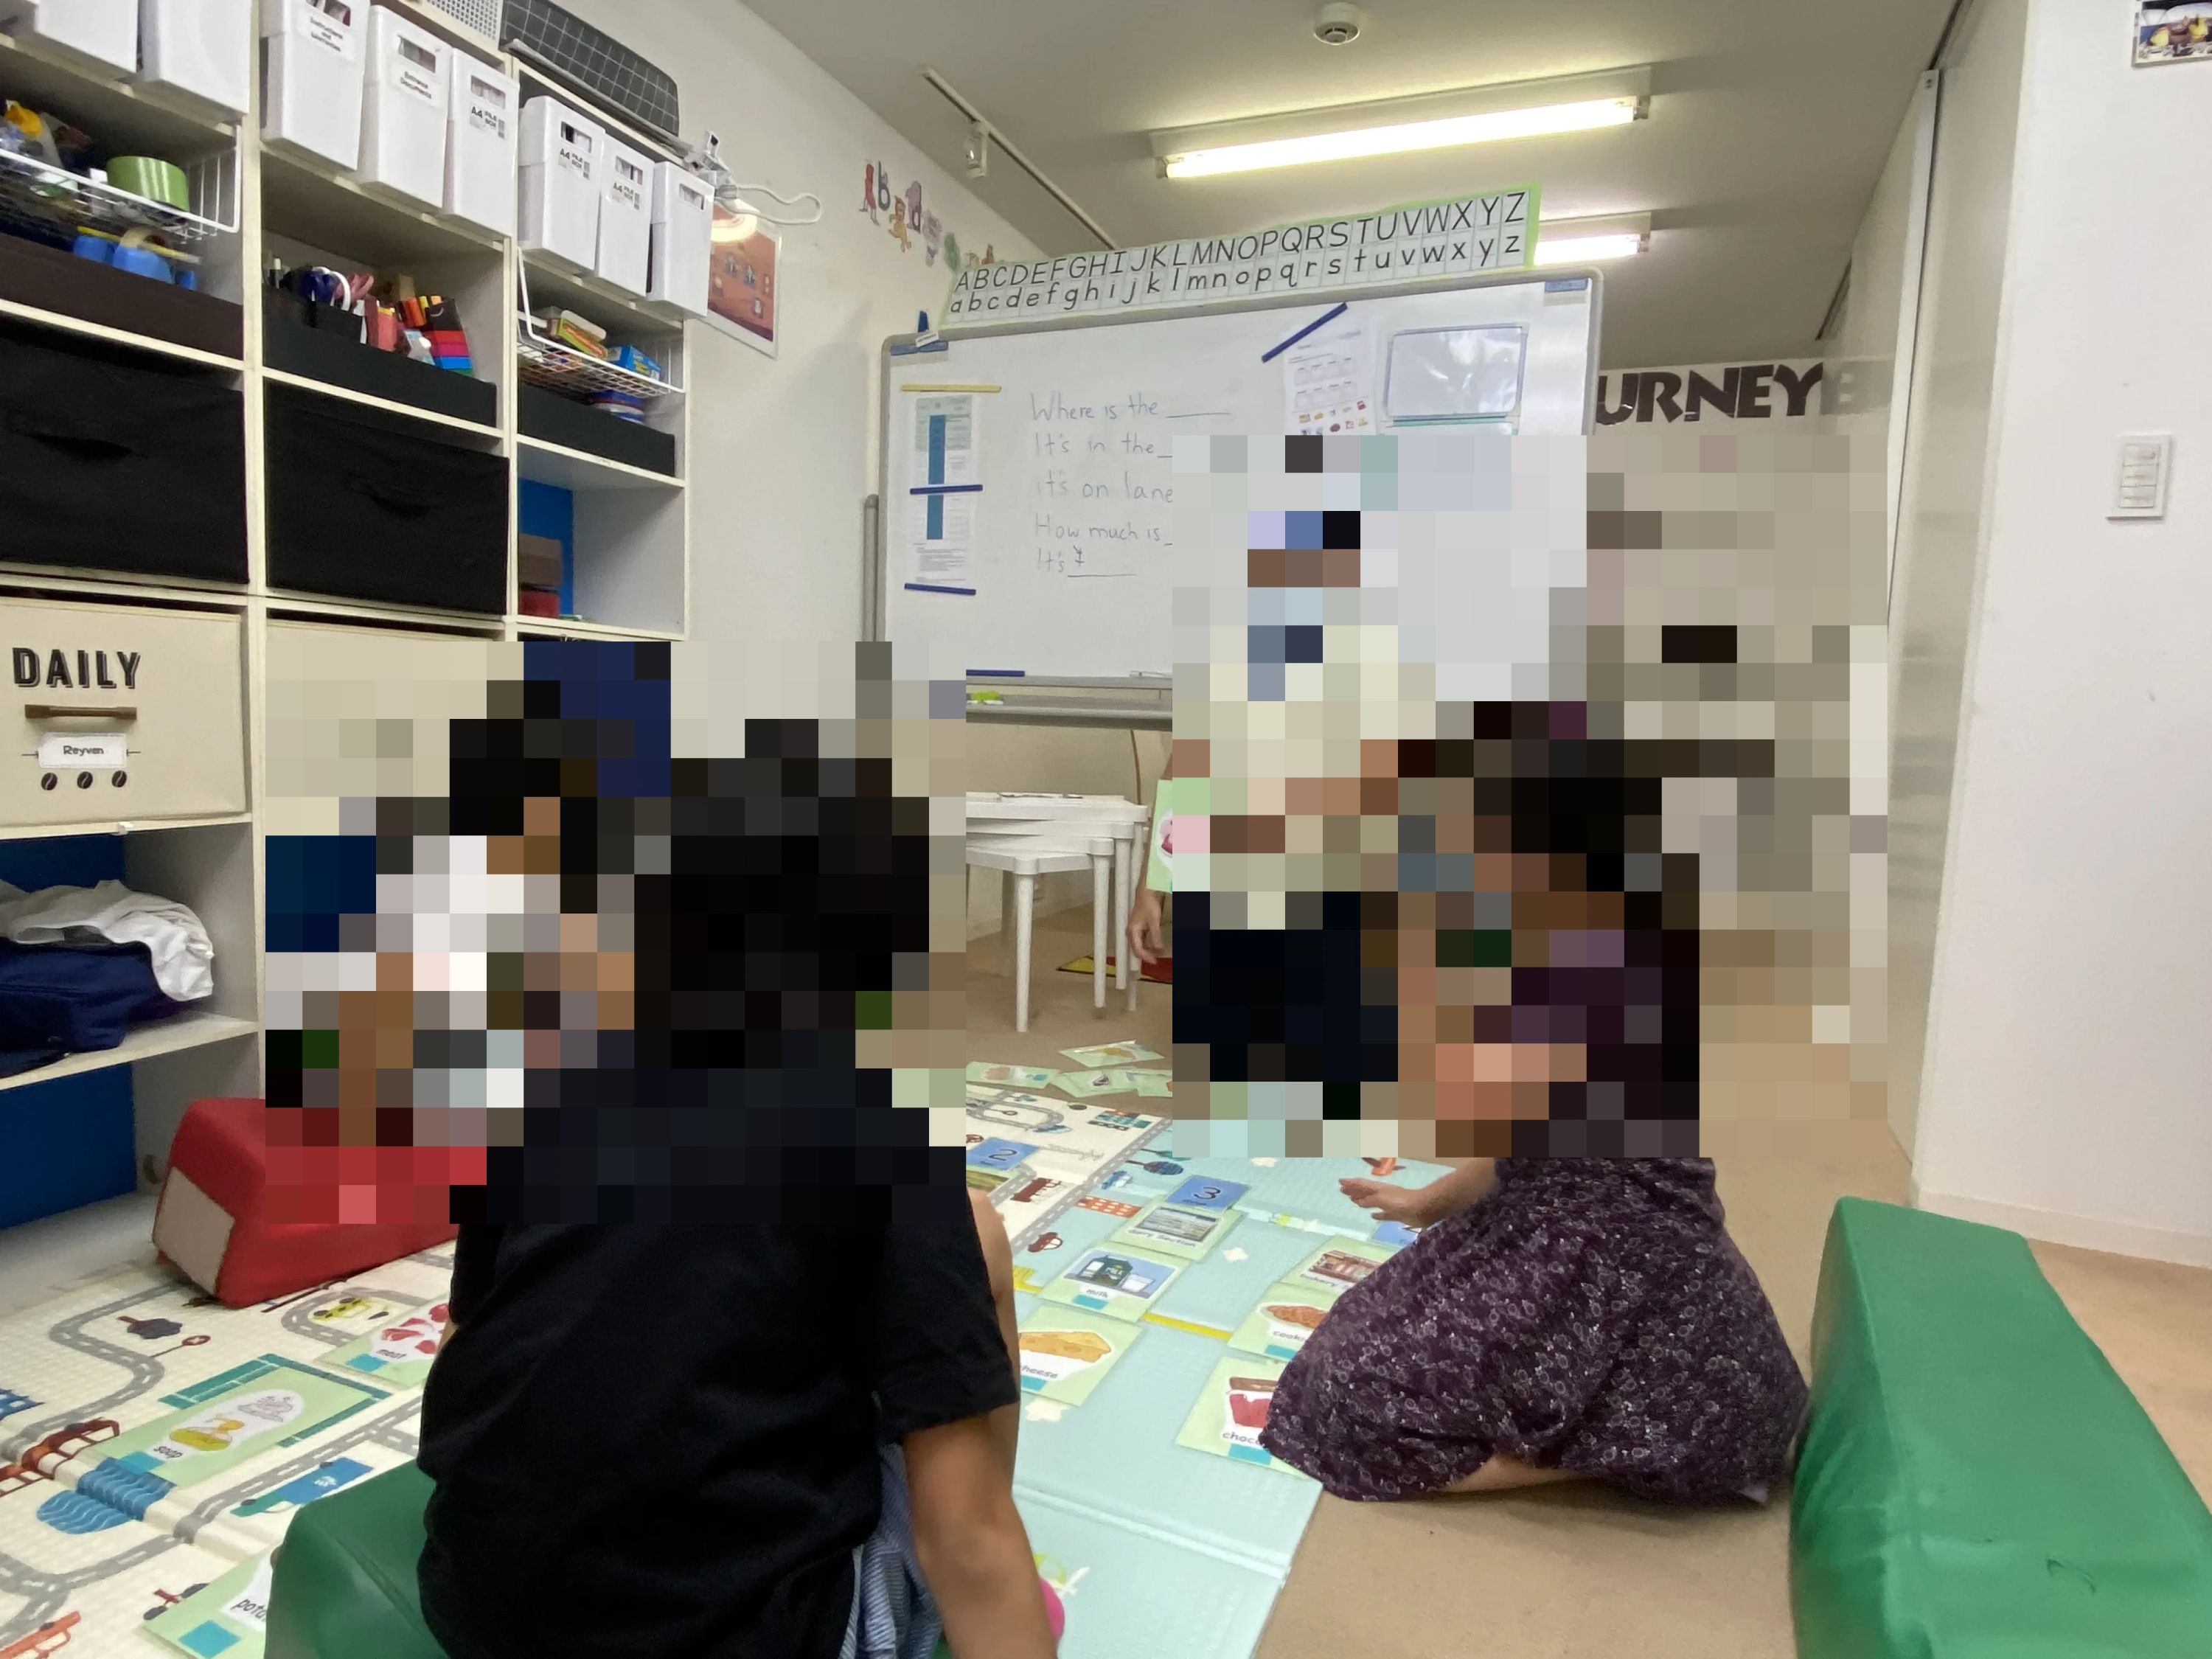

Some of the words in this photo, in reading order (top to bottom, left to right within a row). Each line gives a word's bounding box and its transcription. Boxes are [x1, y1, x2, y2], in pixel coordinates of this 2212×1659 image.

[471, 105, 483, 118] A4
[560, 147, 570, 159] A4
[613, 182, 623, 192] A4
[1030, 389, 1095, 421] Where
[1105, 404, 1118, 420] is
[1128, 391, 1158, 418] the
[1034, 432, 1070, 456] It's
[1088, 438, 1106, 452] in
[1121, 432, 1155, 454] the
[1082, 483, 1109, 498] on
[1124, 470, 1173, 503] lane
[1035, 512, 1079, 539] How
[1089, 521, 1138, 540] much
[1147, 526, 1161, 541] is
[1036, 546, 1065, 573] It's
[12, 647, 141, 689] DAILY
[987, 1148, 1018, 1161] 2
[1193, 1186, 1222, 1200] 3
[1020, 1365, 1059, 1380] heese
